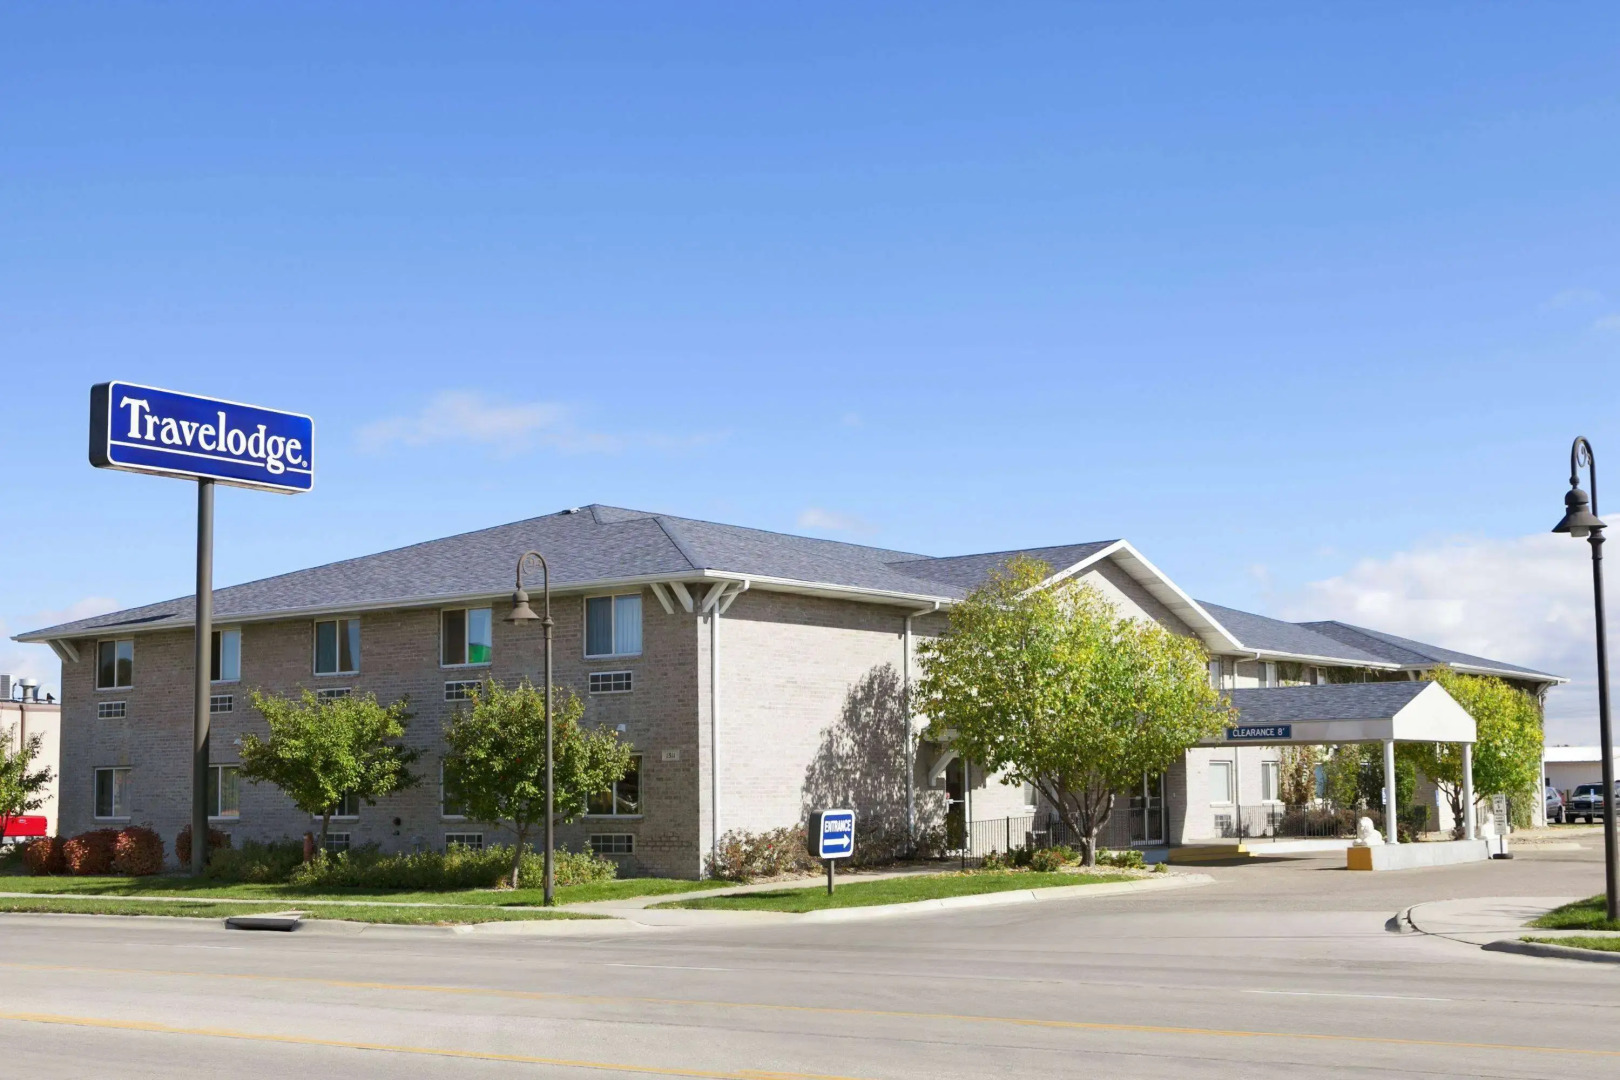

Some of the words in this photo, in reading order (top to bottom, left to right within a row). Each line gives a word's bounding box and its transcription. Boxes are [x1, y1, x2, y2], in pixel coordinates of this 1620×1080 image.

[120, 396, 302, 474] Travelodge
[1232, 728, 1275, 737] CLEARANCE
[824, 819, 851, 833] ENTRANCE
